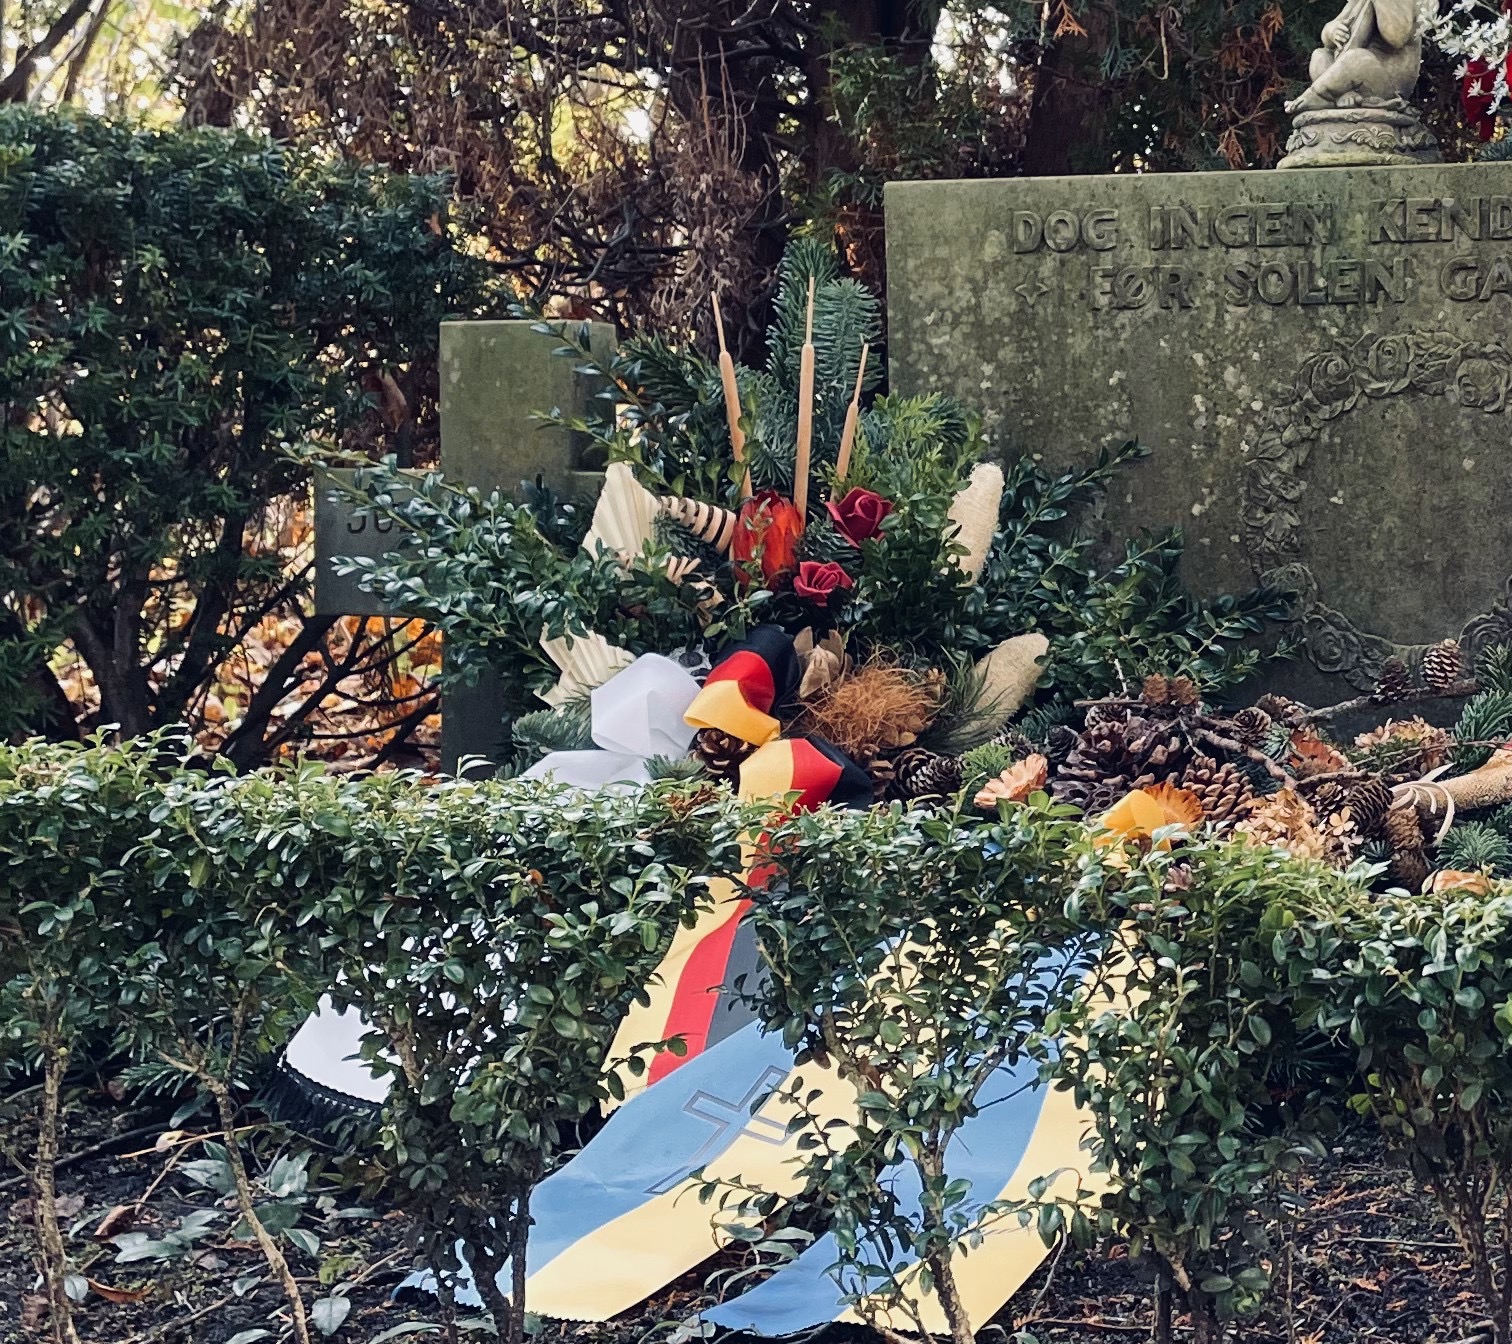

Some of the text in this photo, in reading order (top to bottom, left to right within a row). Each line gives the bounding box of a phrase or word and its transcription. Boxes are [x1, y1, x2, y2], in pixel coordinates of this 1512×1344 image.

[1013, 209, 1119, 254] DOG
[1150, 202, 1332, 249] INGEN
[1091, 263, 1194, 310] FØR
[1224, 256, 1407, 307] SOLEN
